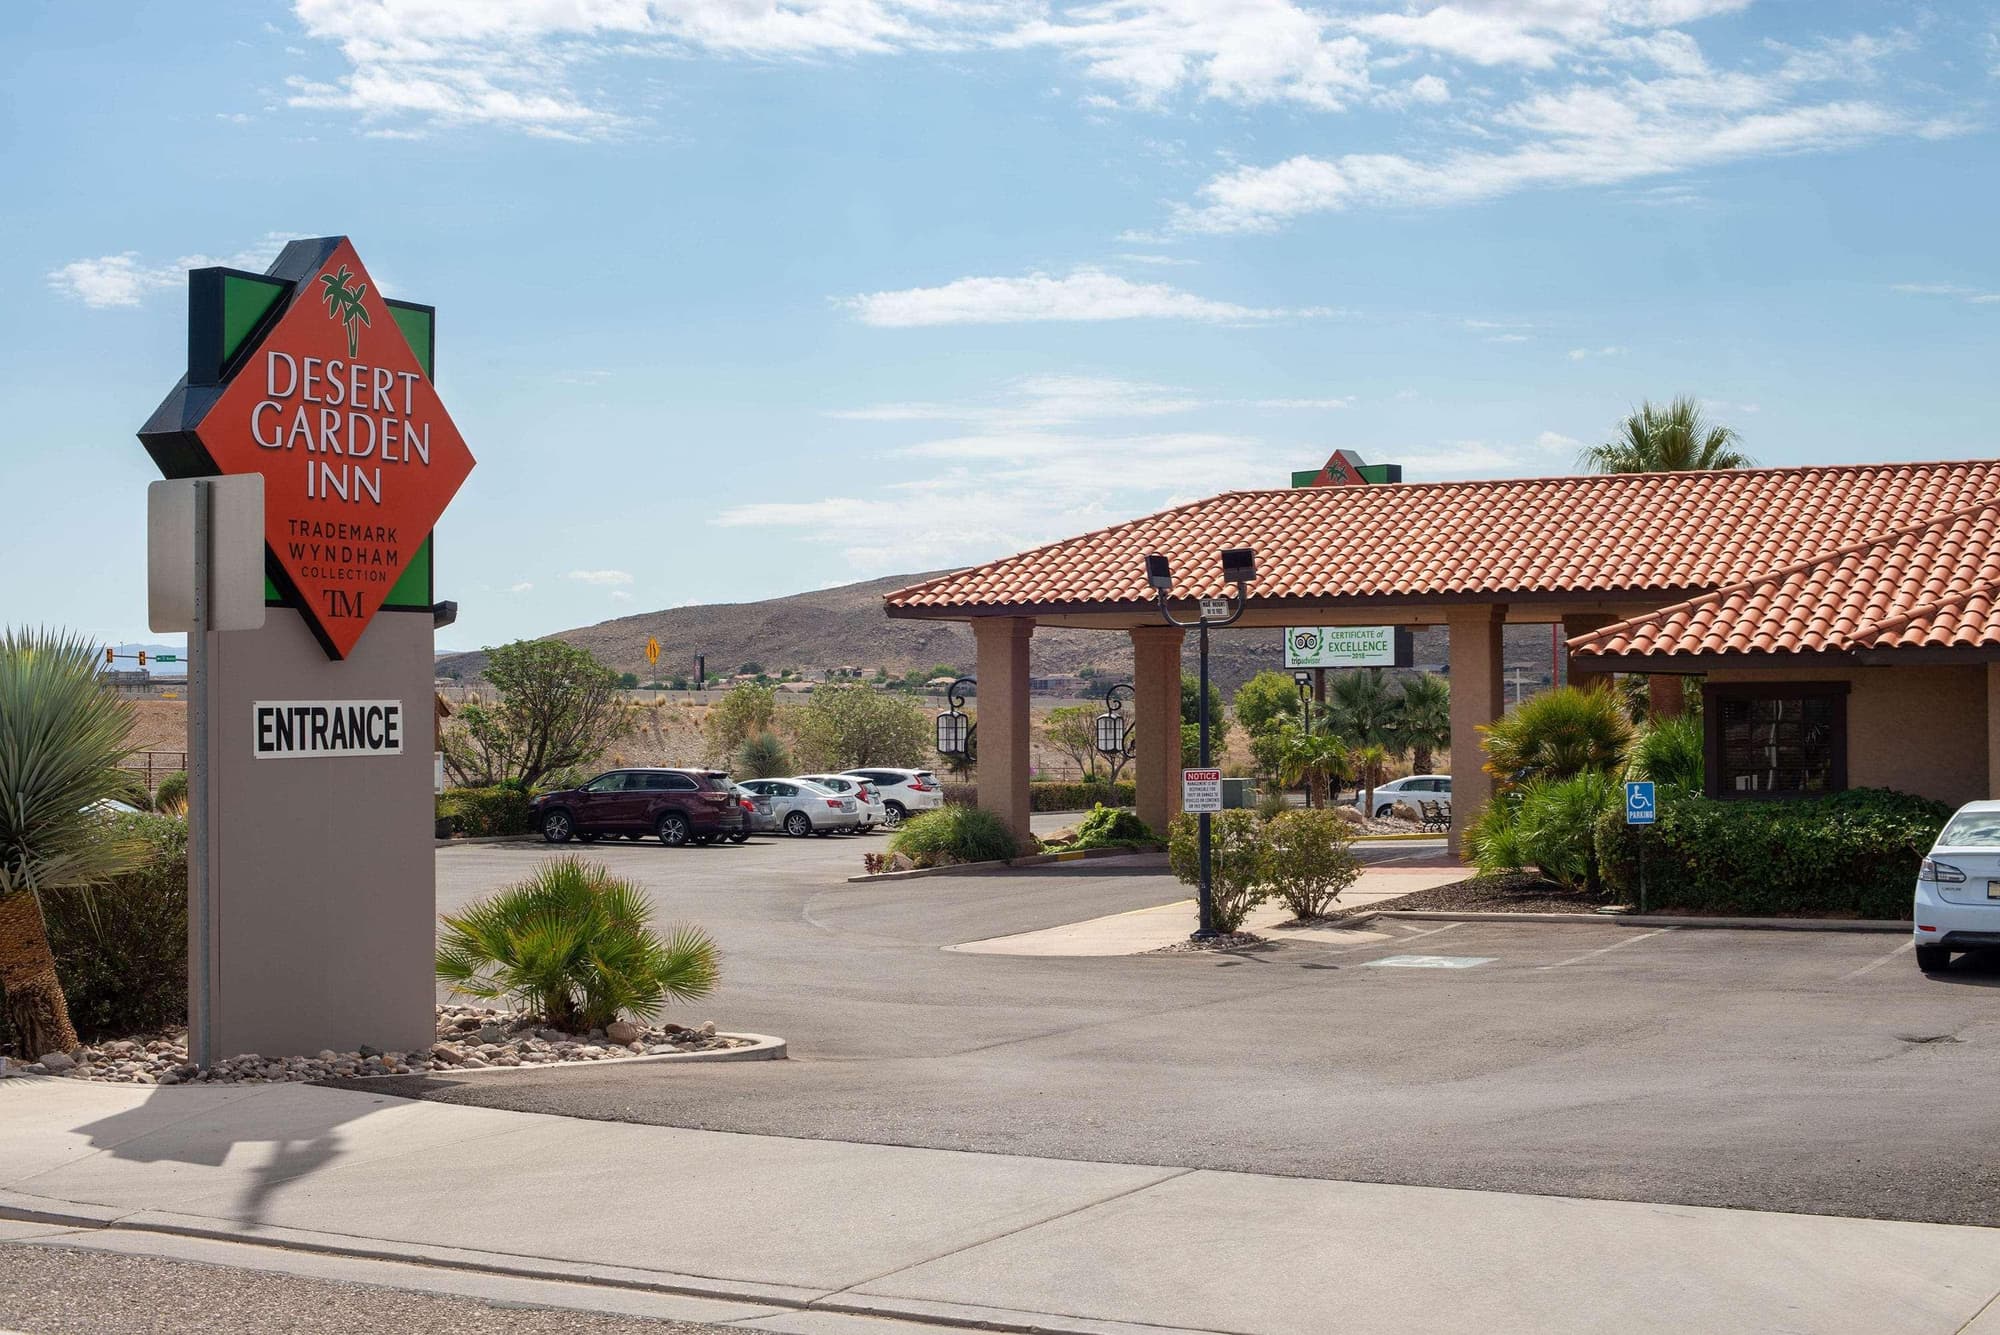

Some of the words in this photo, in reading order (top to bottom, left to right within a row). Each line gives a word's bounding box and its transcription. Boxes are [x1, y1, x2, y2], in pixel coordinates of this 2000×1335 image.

[267, 351, 420, 417] DESERT
[251, 401, 430, 465] GARDEN
[307, 460, 382, 504] INN
[288, 519, 398, 543] TRADEMARK
[288, 542, 399, 567] WYNDHAM
[301, 566, 387, 583] COLLECTION
[323, 589, 365, 619] TM
[1328, 640, 1388, 652] EXCELLENCE
[1331, 631, 1374, 640] CERTIFICATE
[1376, 630, 1384, 638] of
[258, 706, 399, 751] ENTRANCE
[1630, 811, 1653, 819] PARKING
